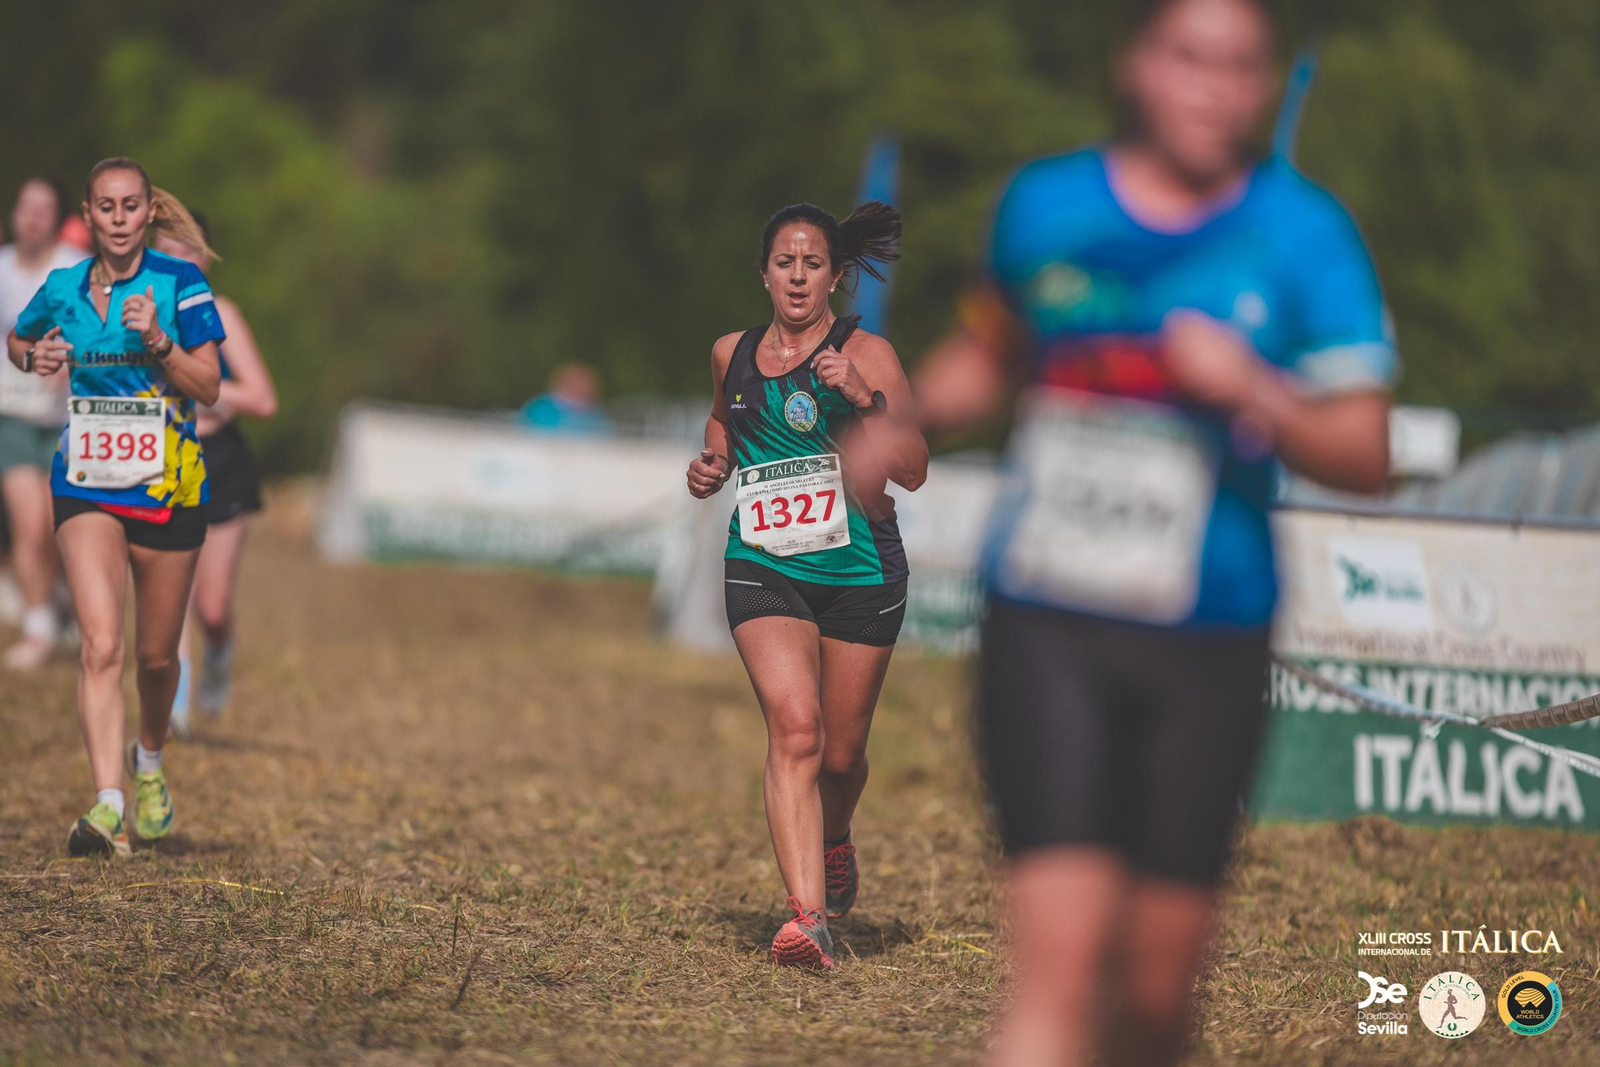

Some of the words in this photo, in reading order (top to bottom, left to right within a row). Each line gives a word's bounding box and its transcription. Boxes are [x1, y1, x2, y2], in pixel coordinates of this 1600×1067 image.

[79, 431, 157, 462] 1398
[765, 462, 812, 478] ITÁLICA
[750, 489, 836, 532] 1327
[1264, 661, 1359, 714] ROSS
